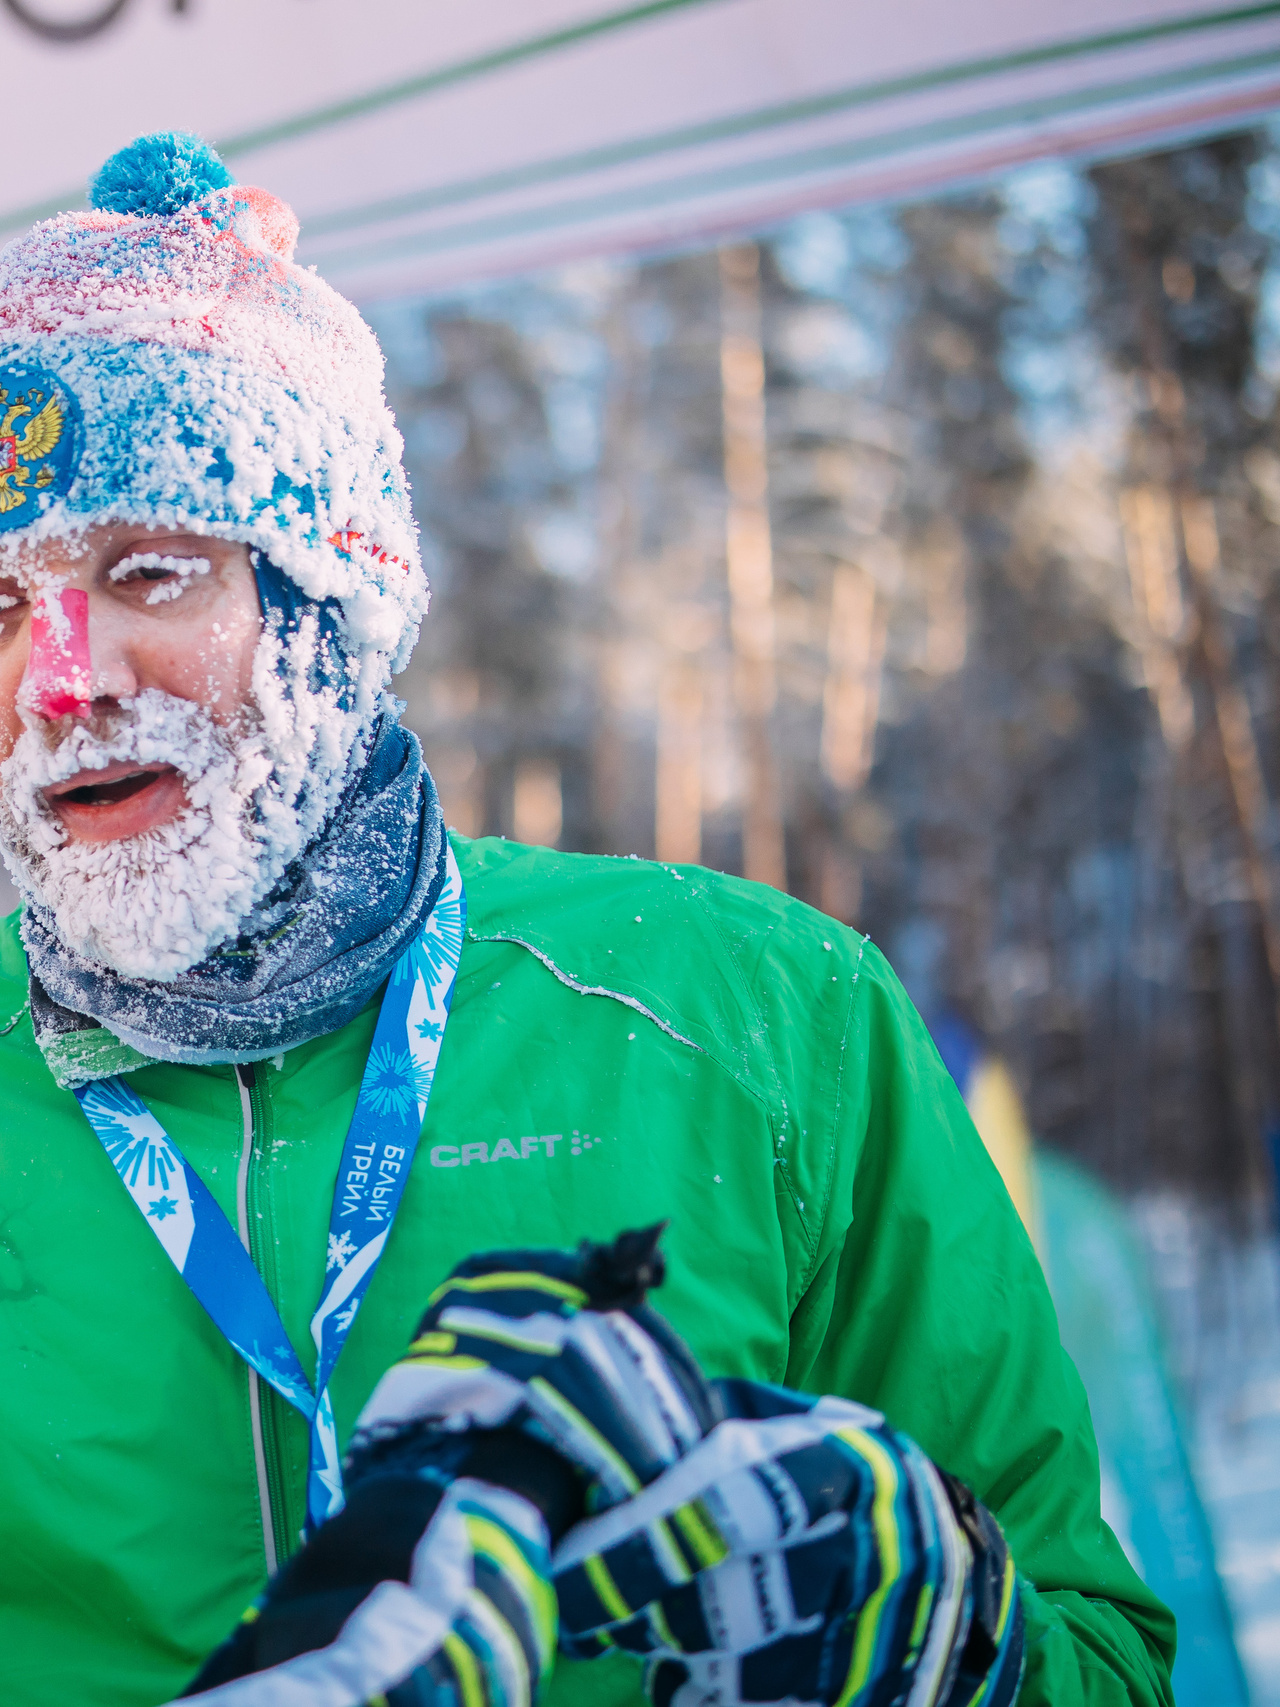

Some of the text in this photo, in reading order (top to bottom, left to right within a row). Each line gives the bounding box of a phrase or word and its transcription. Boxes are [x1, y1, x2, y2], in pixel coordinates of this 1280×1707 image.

[339, 1141, 377, 1217] ТРЕЙЛ
[365, 1144, 406, 1221] БЕЛЫЙ
[429, 1134, 563, 1168] CRAFT
